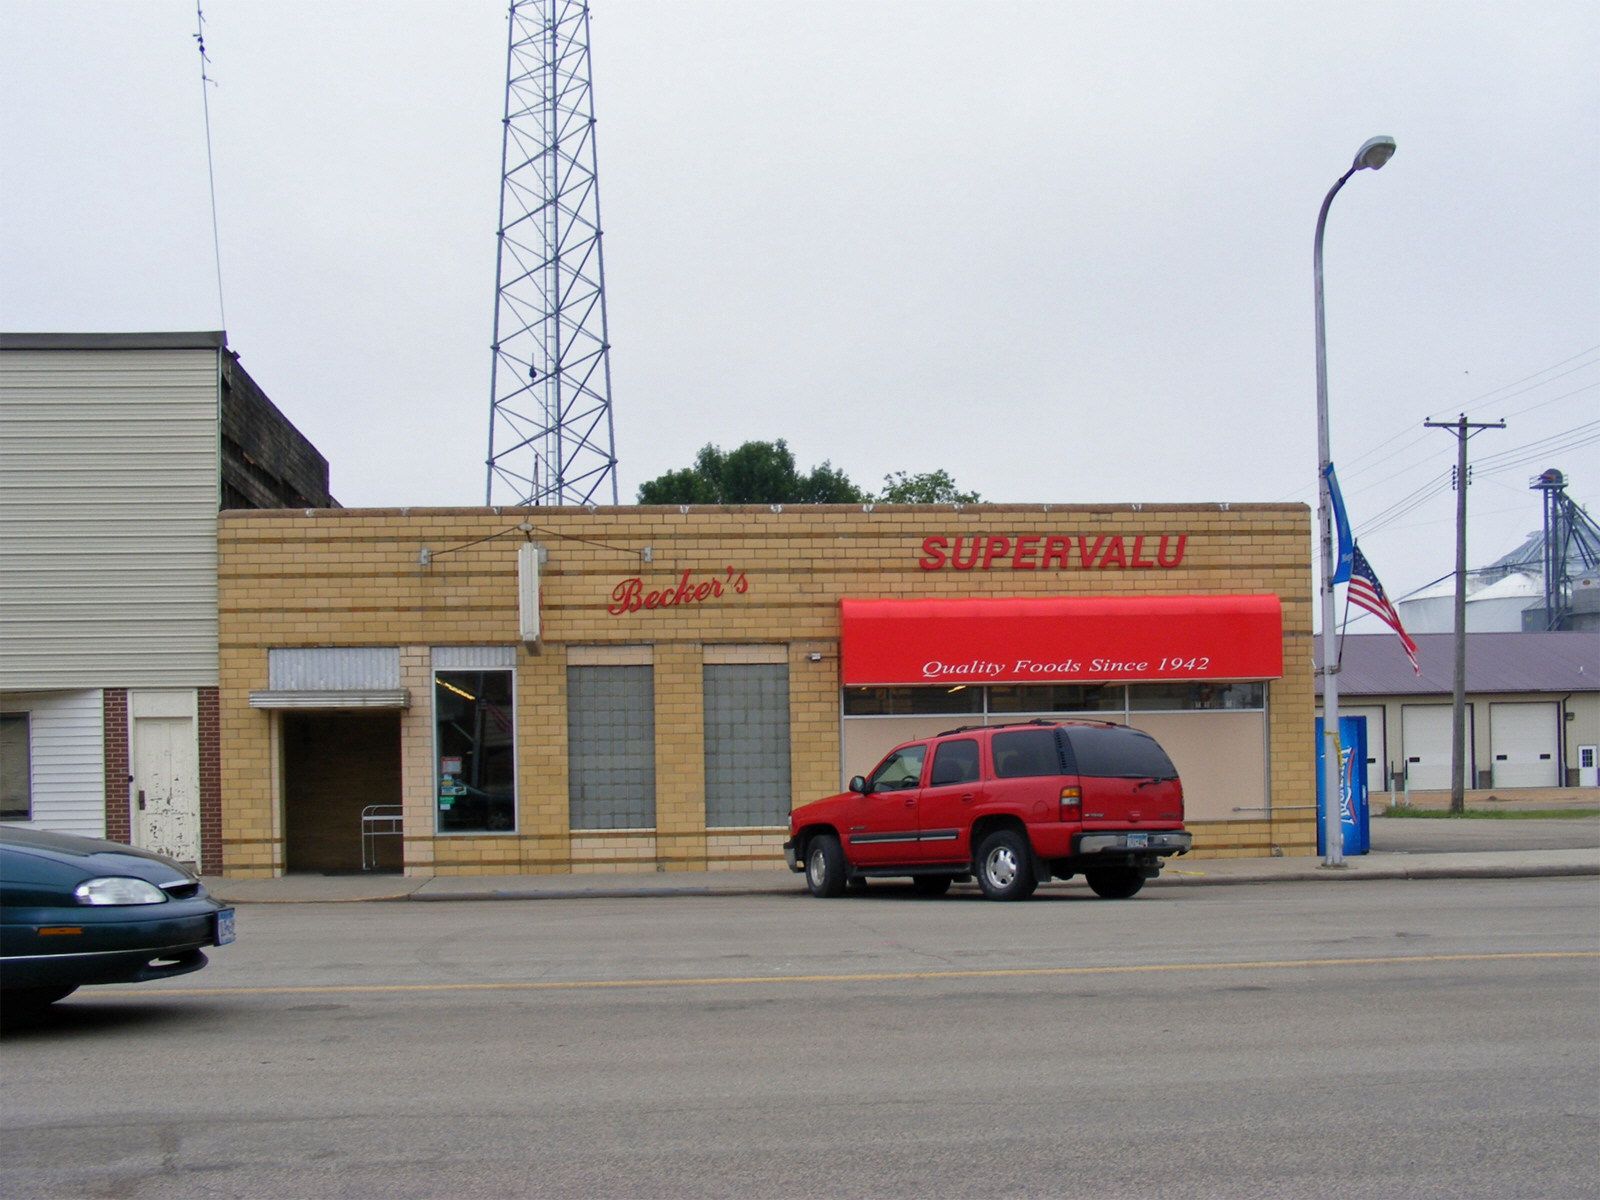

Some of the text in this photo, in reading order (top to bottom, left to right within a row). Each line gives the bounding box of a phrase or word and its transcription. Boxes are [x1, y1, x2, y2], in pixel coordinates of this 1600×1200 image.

[918, 534, 1187, 570] SUPERVALU
[607, 565, 748, 616] Becker's
[922, 656, 1210, 679] Quality Foods Since 1942
